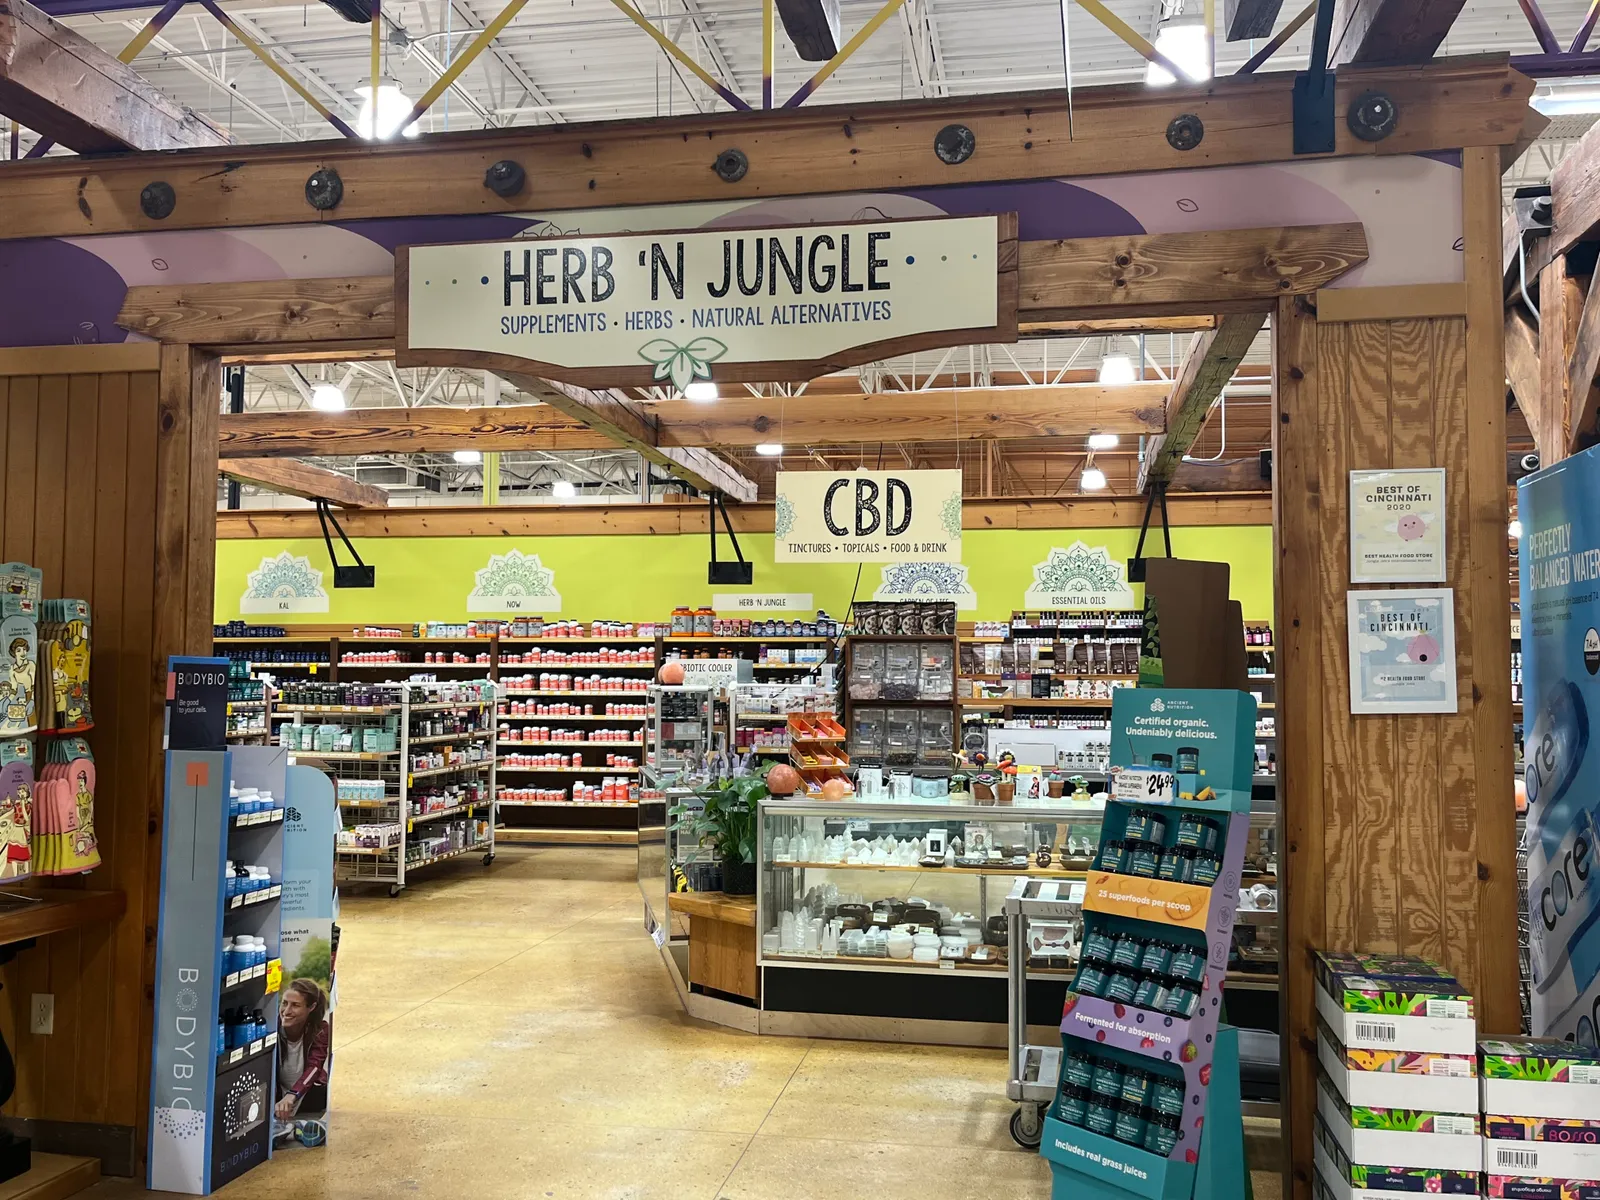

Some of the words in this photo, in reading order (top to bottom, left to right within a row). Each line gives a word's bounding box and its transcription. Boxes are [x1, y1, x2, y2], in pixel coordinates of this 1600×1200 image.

[503, 246, 616, 307] HERB
[639, 242, 686, 302] 'N
[706, 231, 892, 299] JUNGLE
[500, 312, 607, 335] SUPPLEMENTS
[624, 309, 674, 331] HERBS
[691, 306, 765, 329] NATURAL
[770, 300, 892, 325] ALTERNATIVES
[1376, 486, 1403, 494] BEST
[1407, 485, 1421, 493] OF
[1366, 493, 1432, 503] CINCINNATI
[822, 478, 913, 538] CBD
[788, 543, 831, 554] TINCTURES
[842, 543, 880, 554] TOPICALS
[890, 543, 912, 553] FOOD
[913, 543, 919, 553] &
[921, 542, 948, 553] DRINK
[1529, 522, 1572, 561] PERFECTLY
[1530, 556, 1570, 591] BALANCED
[1573, 548, 1600, 582] WATER
[278, 601, 290, 610] KAL
[506, 599, 522, 609] NOW
[738, 598, 754, 607] HERB
[764, 598, 786, 607] JUNGLE
[1051, 595, 1088, 606] ESSENTIAL
[1090, 595, 1107, 606] OILS
[1380, 613, 1404, 622] BEST
[1410, 612, 1421, 622] OF
[681, 663, 706, 672] BIOTIC
[708, 663, 733, 672] COOLER
[178, 672, 225, 686] BODYBIO
[187, 699, 199, 708] good
[1134, 716, 1172, 727] Certified
[1173, 718, 1209, 729] organic.
[1125, 727, 1174, 739] Undeniably
[1175, 729, 1218, 740] delicious.
[1527, 732, 1555, 809] ore
[1540, 836, 1590, 932] core
[1098, 890, 1108, 898] 25
[1108, 891, 1151, 906] superfoods
[1151, 899, 1166, 908] per
[1166, 901, 1191, 912] scoop
[1075, 1012, 1115, 1029] Fermented
[1115, 1022, 1127, 1033] for
[1127, 1024, 1171, 1044] absorption
[220, 1142, 259, 1173] BODYBIO
[1055, 1139, 1085, 1157] Includes
[1086, 1151, 1101, 1163] real
[1101, 1157, 1123, 1171] grass
[1123, 1163, 1147, 1180] juices
